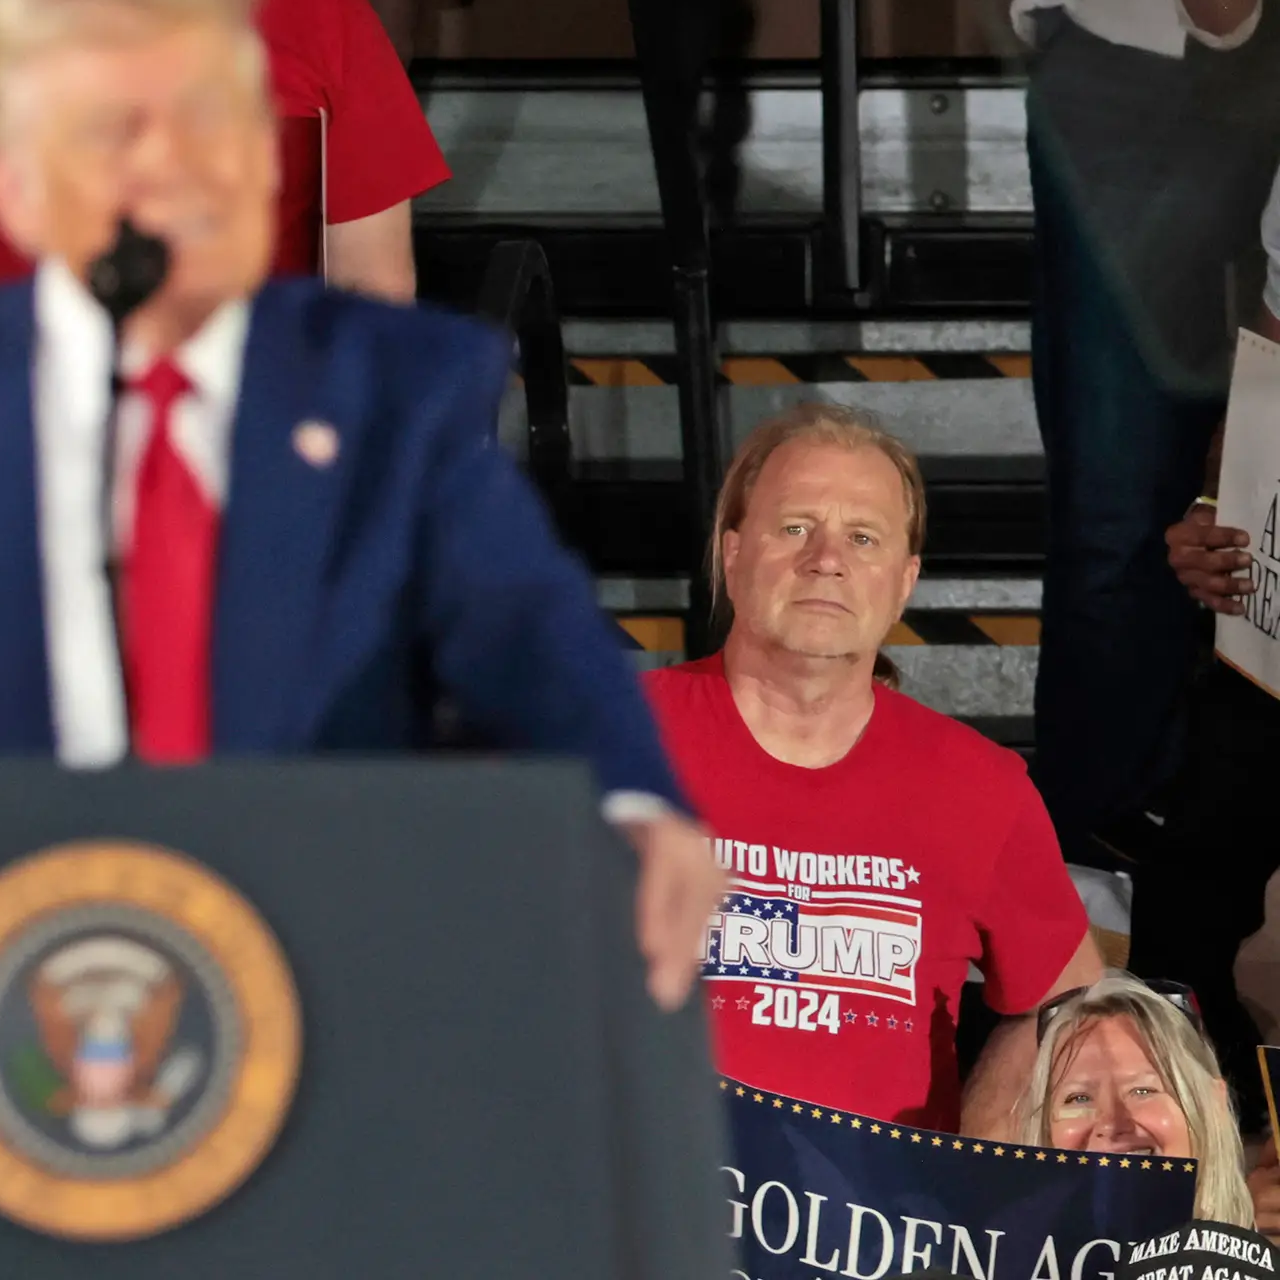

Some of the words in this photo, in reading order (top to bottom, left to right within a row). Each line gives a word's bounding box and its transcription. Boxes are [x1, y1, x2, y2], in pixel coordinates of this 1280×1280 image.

[772, 846, 907, 891] WORKERS
[787, 883, 811, 901] FOR
[751, 984, 841, 1035] 2024
[1129, 1231, 1180, 1265] MAKE
[1183, 1228, 1275, 1272] AMERICA
